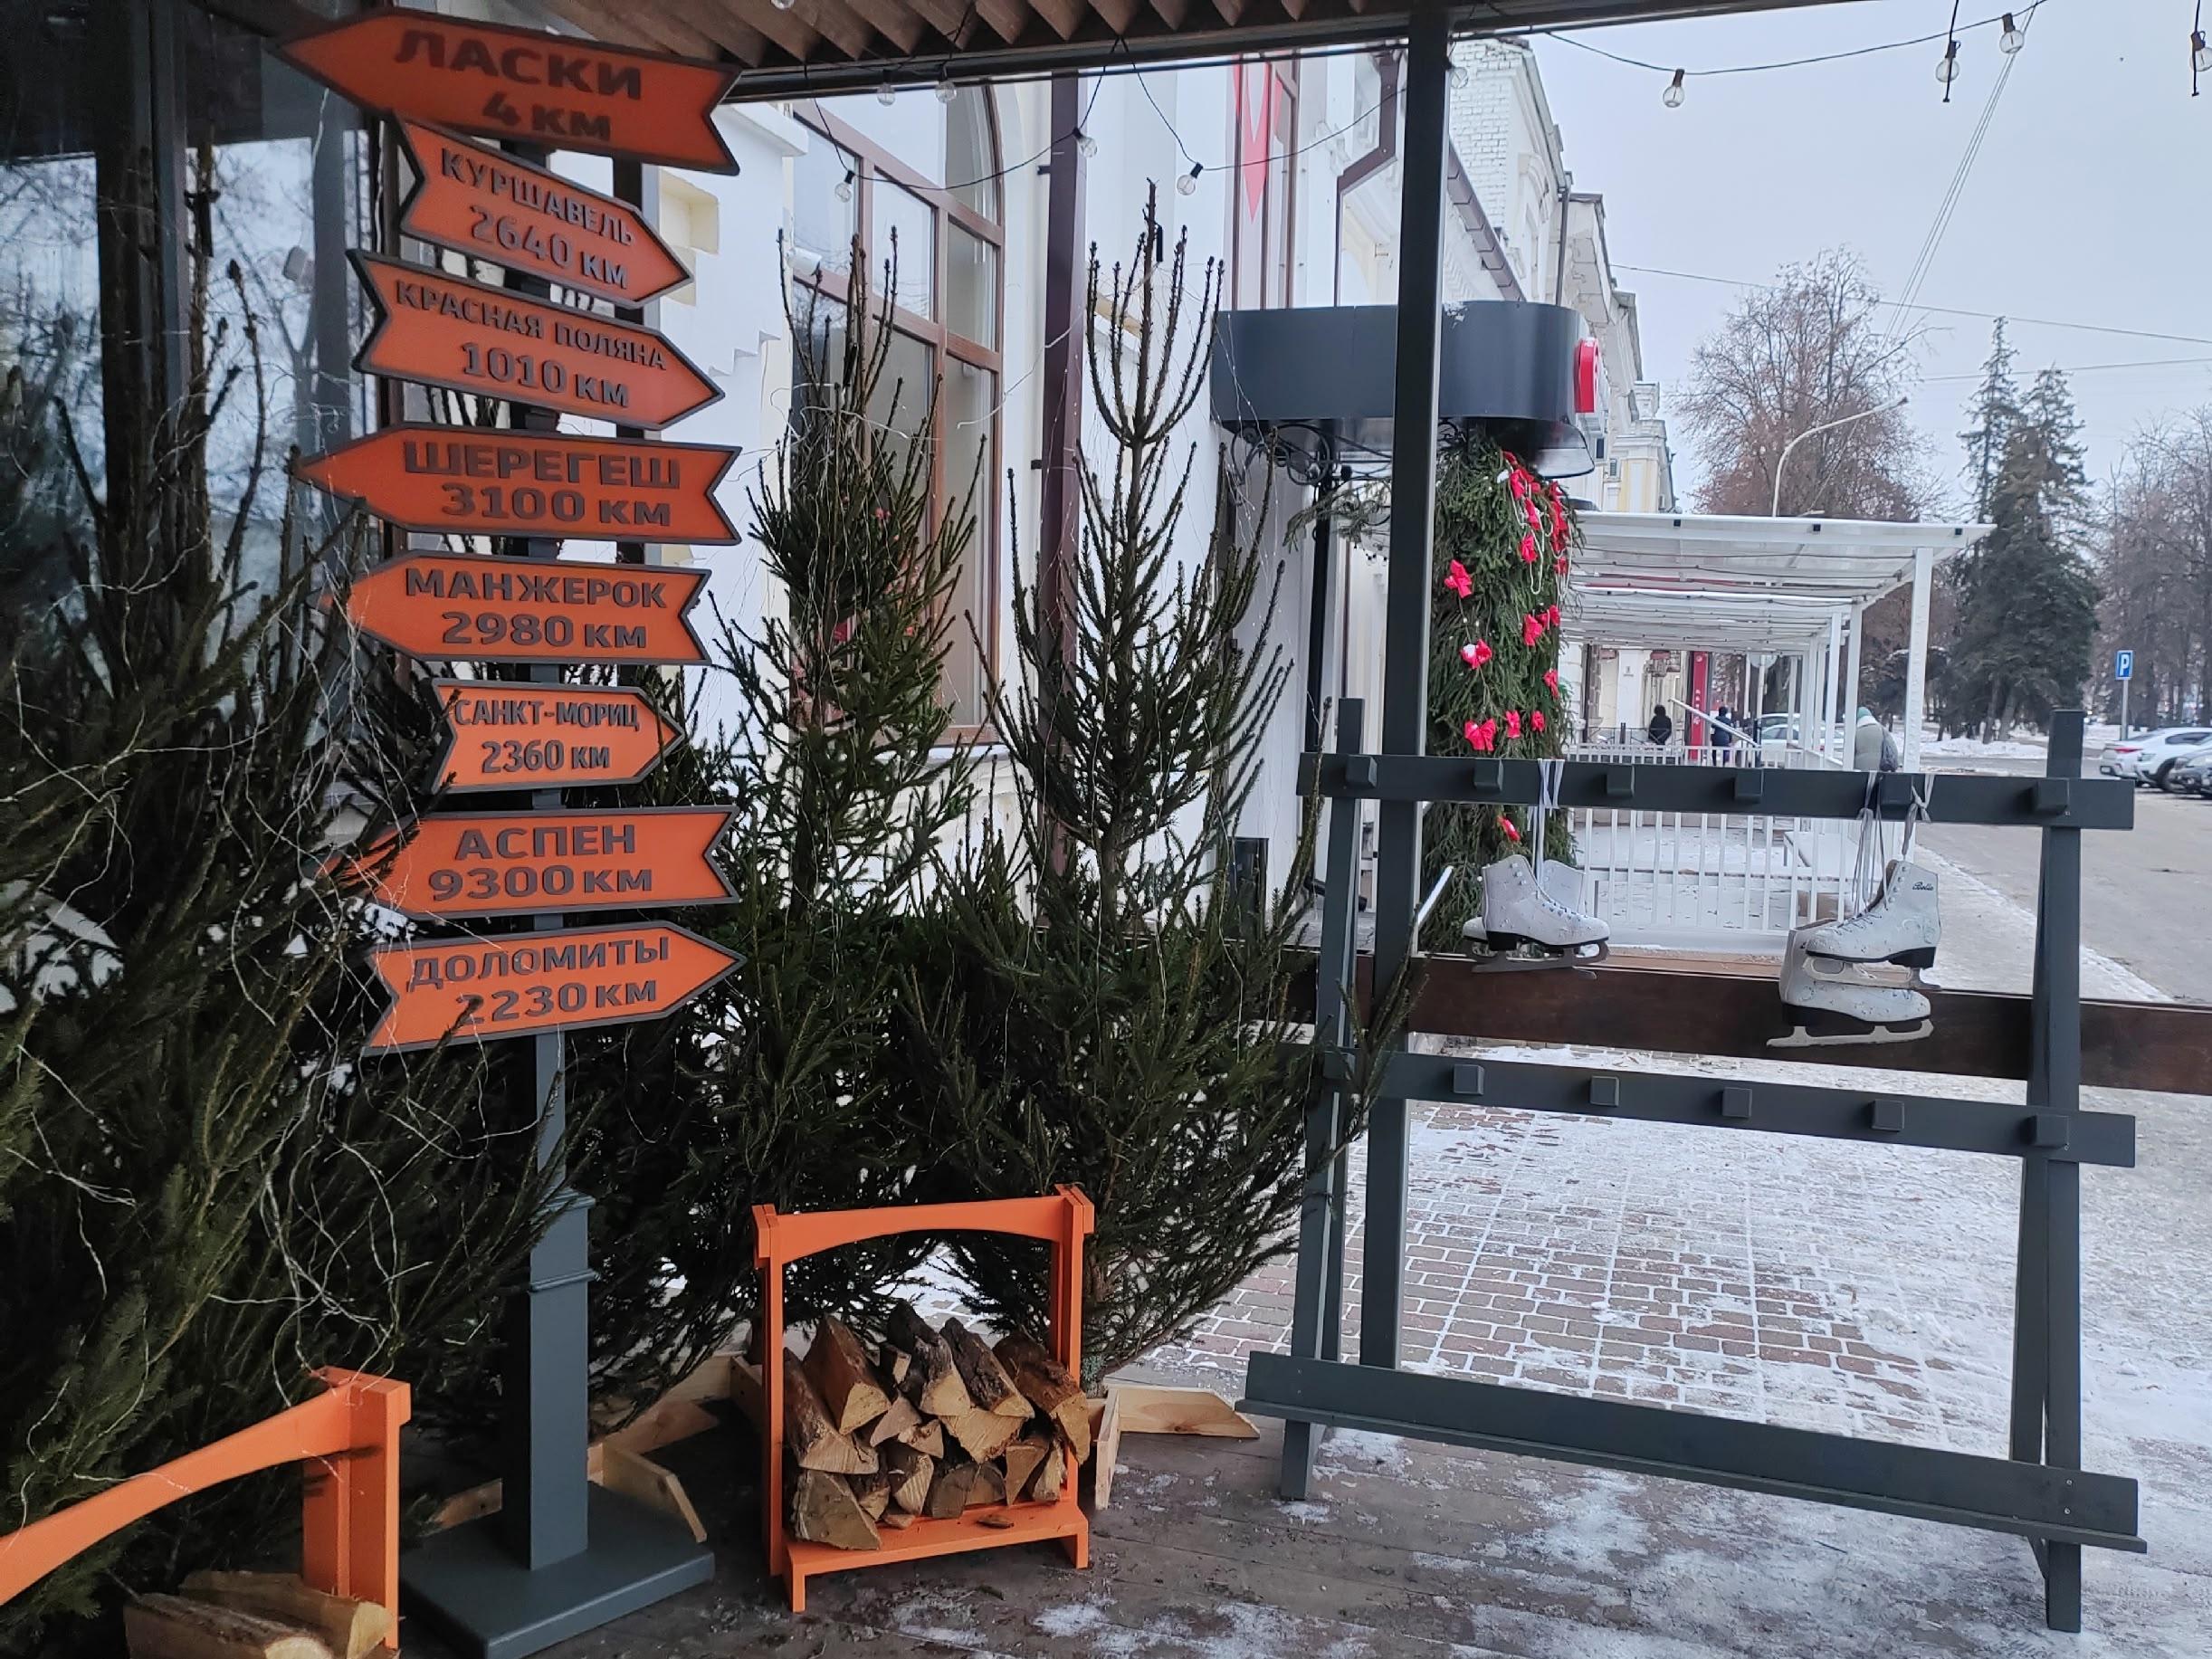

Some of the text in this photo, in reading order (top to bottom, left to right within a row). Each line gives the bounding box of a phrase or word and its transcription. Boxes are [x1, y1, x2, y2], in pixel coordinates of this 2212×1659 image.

[395, 30, 641, 100] ЛАСКИ
[481, 91, 520, 127] 4
[441, 148, 634, 246] КУРШАВЕЛЬ
[470, 205, 573, 269] 2640
[396, 281, 667, 371] КРАСНАЯ ПОЛЯНА
[462, 342, 567, 394] 1010
[403, 441, 679, 488] ШЕРЕГЕШ
[442, 482, 585, 522] 3100
[405, 567, 667, 608] МАНЖЕРОК
[442, 611, 574, 647] 2980
[454, 698, 640, 731] САНКТ-МОРИЦ
[481, 739, 564, 773] 2360
[454, 824, 636, 861] АСПЕН
[428, 864, 575, 901] 9300
[406, 936, 670, 992] ДОЛОМИТЫ
[455, 982, 587, 1025] 2230
